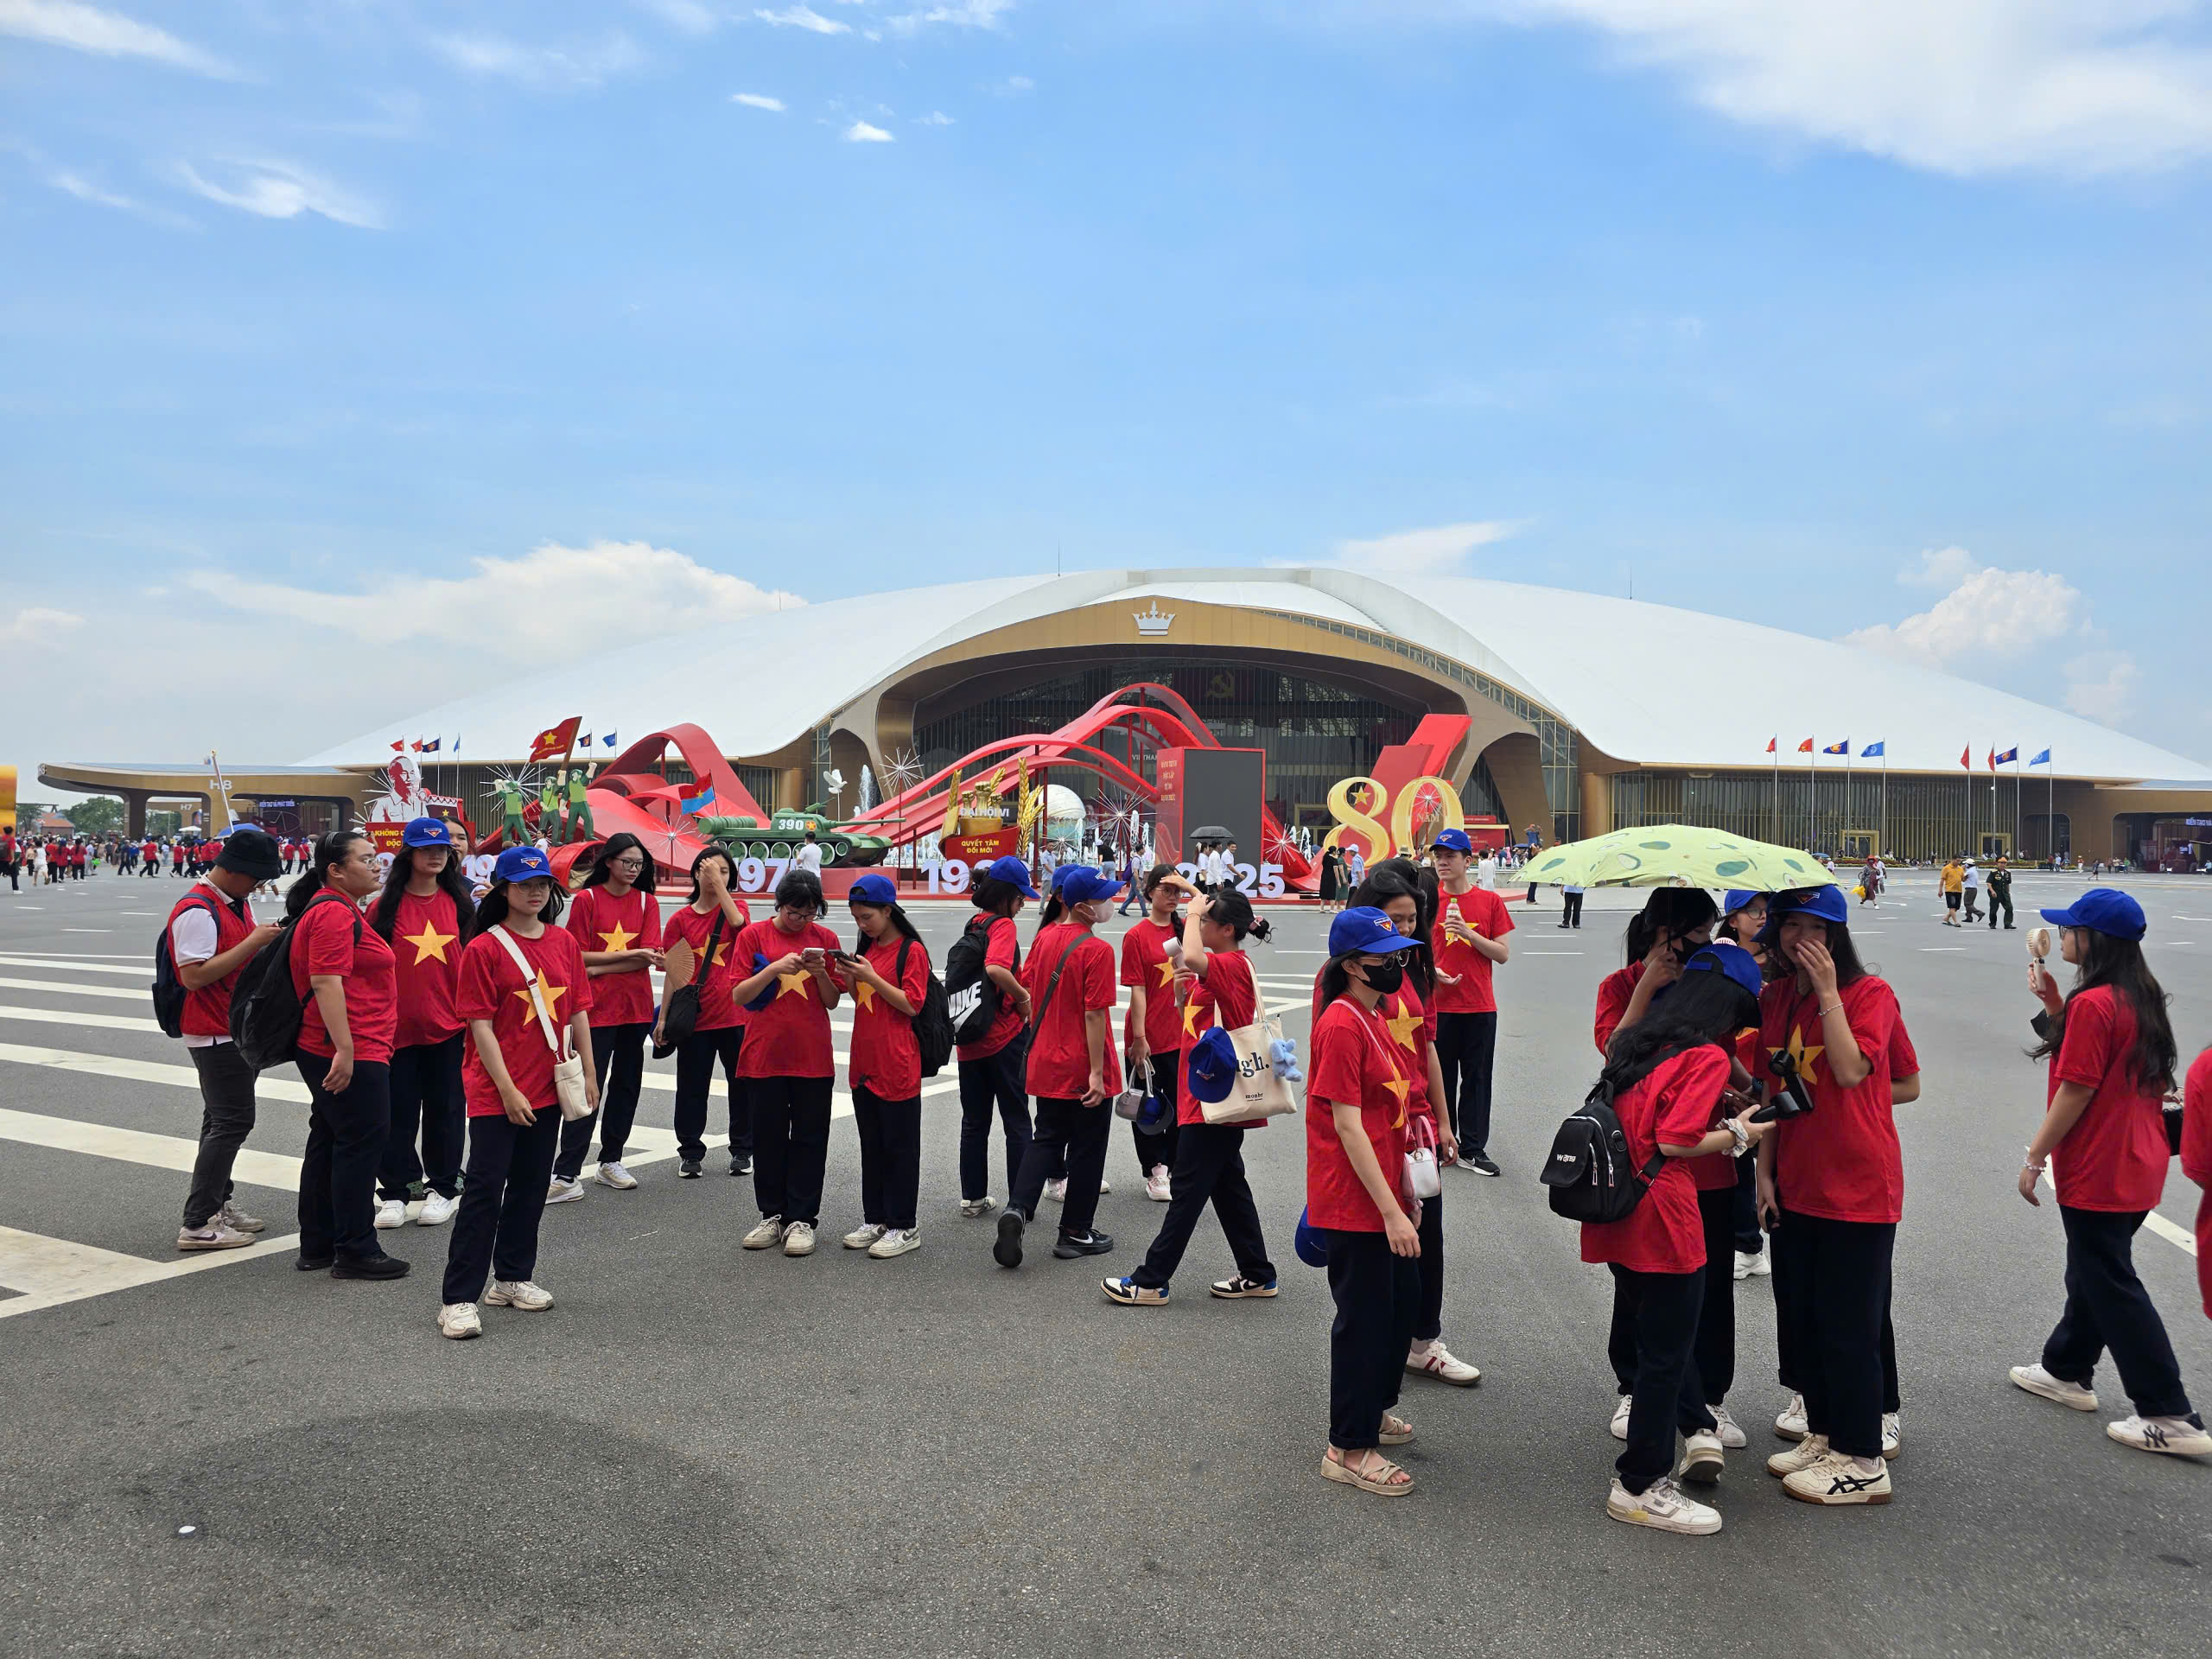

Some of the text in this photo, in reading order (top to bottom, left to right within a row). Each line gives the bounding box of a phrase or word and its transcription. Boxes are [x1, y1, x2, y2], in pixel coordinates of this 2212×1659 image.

[209, 779, 232, 791] H8
[778, 819, 804, 830] 390
[1000, 808, 1010, 817] VI
[1323, 776, 1465, 868] 80
[386, 839, 402, 849] ĐỘC
[733, 857, 803, 893] 97
[1175, 862, 1286, 899] 225
[948, 981, 982, 1019] NIKE
